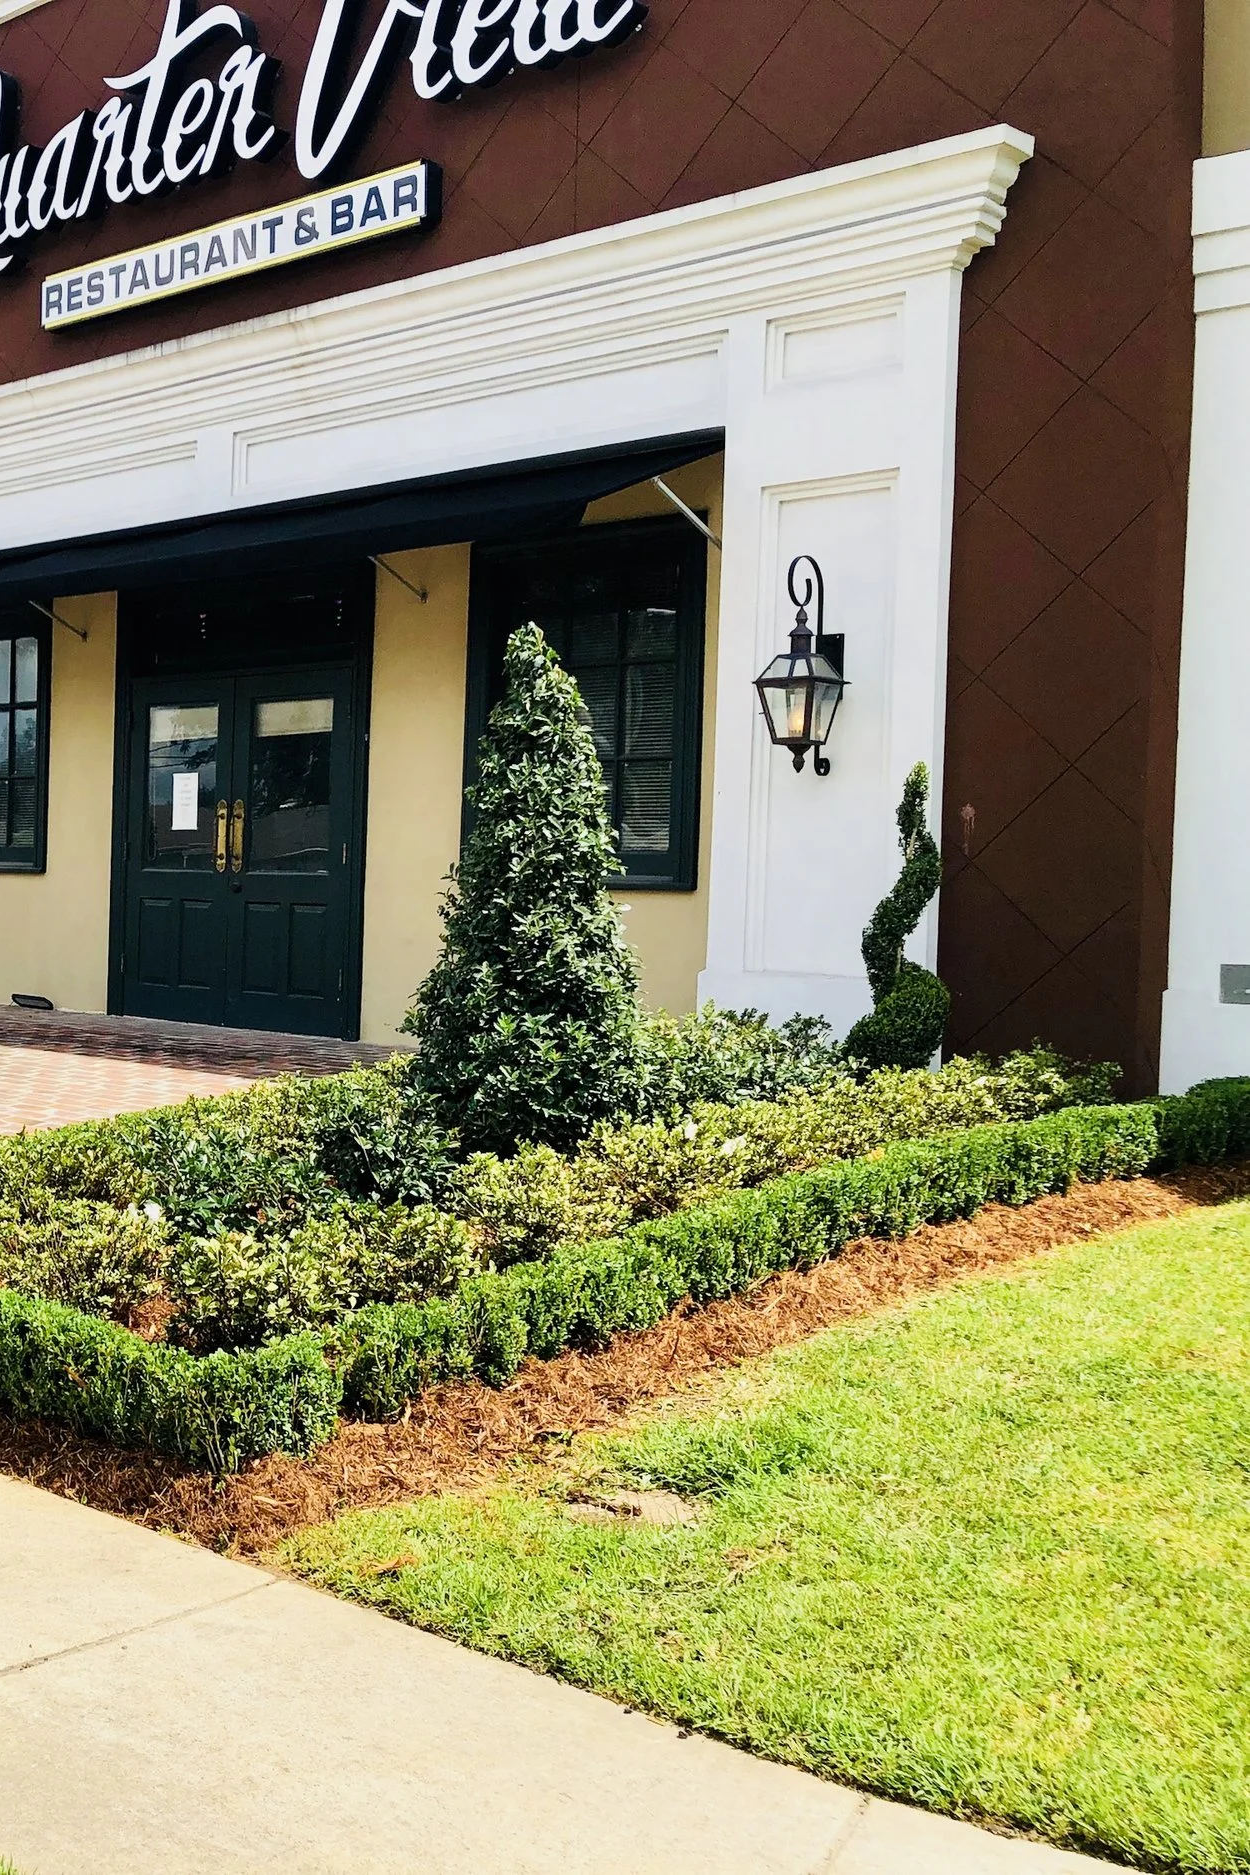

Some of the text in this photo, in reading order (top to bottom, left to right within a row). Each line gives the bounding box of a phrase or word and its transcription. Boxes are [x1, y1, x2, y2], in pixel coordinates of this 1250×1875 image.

[45, 174, 419, 319] RESTAURANT & BAR
